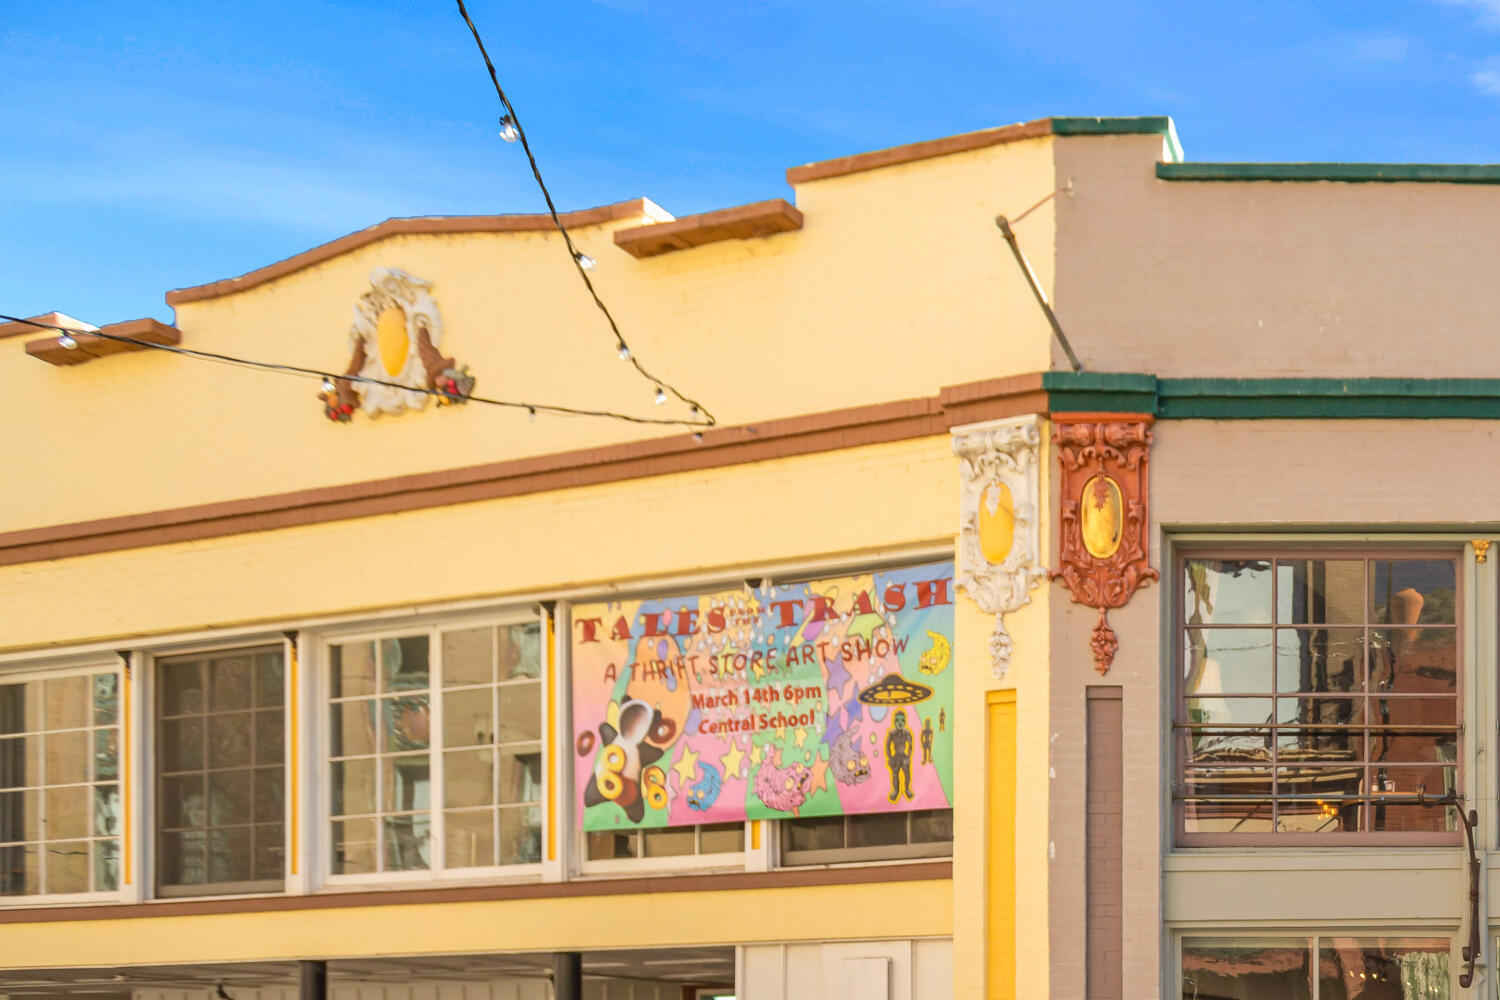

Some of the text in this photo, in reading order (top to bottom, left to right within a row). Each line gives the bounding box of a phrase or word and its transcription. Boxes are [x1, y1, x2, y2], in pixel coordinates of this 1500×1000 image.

[575, 606, 726, 644] TALES
[769, 577, 953, 630] TRASH
[603, 634, 910, 683] A THRIFT STORE ART SHOW
[691, 684, 822, 710] March 14th 6pm
[698, 708, 815, 735] Central School
